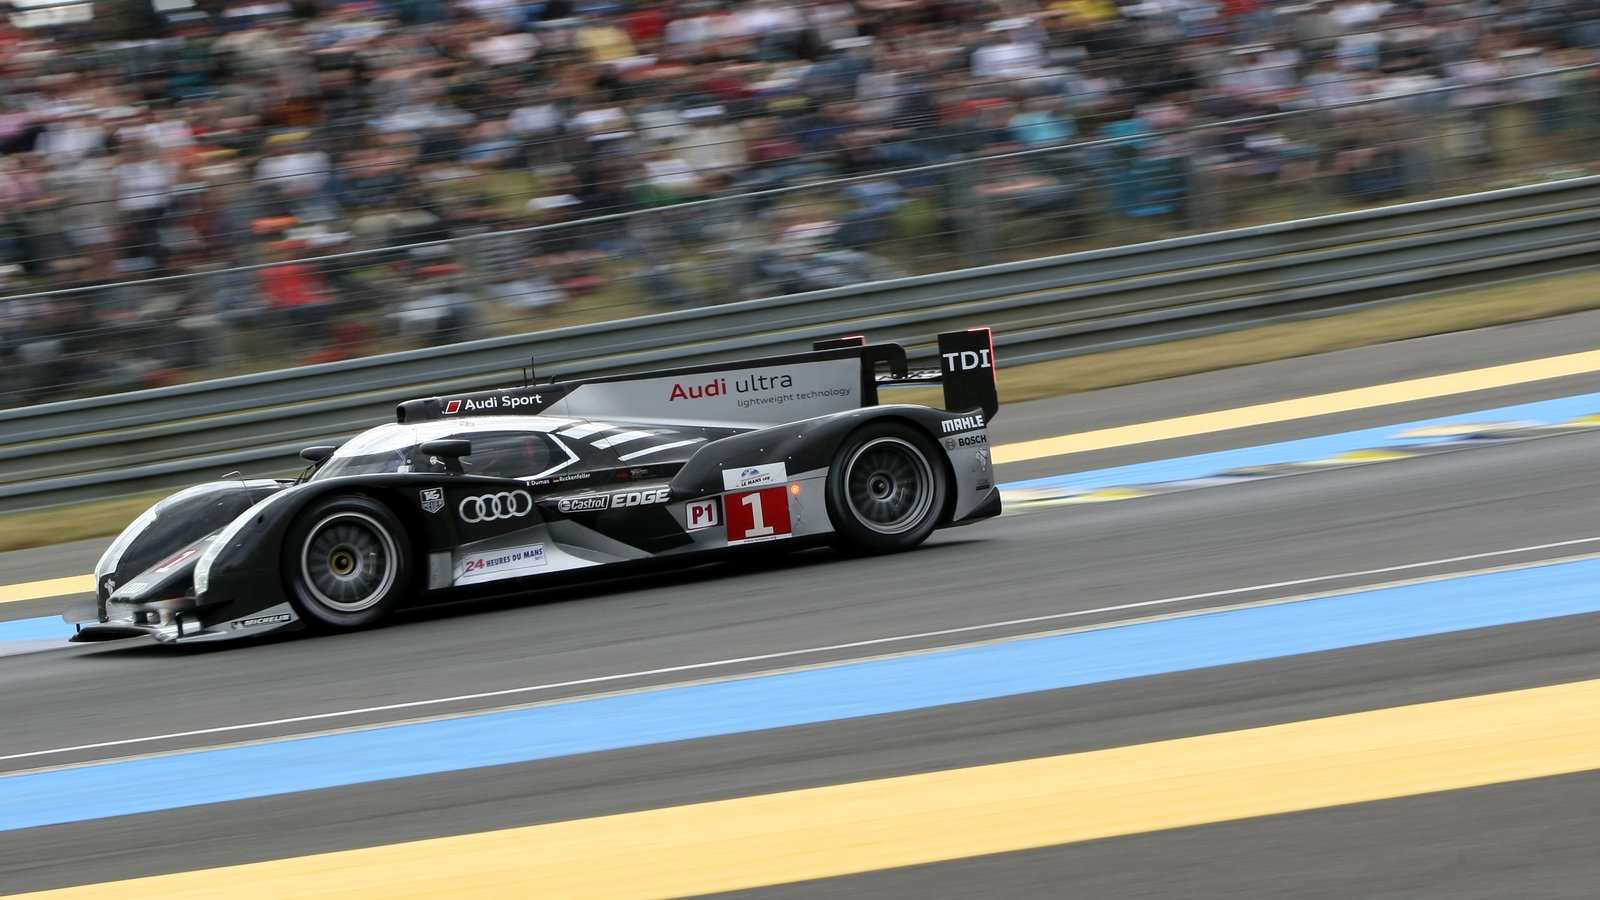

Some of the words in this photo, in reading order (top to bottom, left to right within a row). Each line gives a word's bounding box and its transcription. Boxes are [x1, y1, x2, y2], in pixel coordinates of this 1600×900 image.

[942, 349, 992, 372] TDI
[669, 378, 727, 402] Audi
[735, 374, 793, 393] ultra
[737, 393, 794, 408] lightweight
[796, 387, 851, 401] technology
[464, 397, 498, 411] Audi
[501, 394, 543, 409] Sport
[941, 414, 985, 433] MAHLE
[958, 434, 987, 447] BOSCH
[531, 478, 550, 486] Dumas
[423, 490, 441, 501] TAG
[571, 495, 606, 510] Castrol
[610, 489, 671, 509] EDGE
[692, 503, 714, 525] P1
[741, 492, 775, 538] 1
[465, 558, 486, 573] 24
[486, 555, 510, 568] HEURES
[512, 553, 522, 562] DU
[523, 548, 543, 559] MANS
[244, 614, 290, 626] MICHELIN
